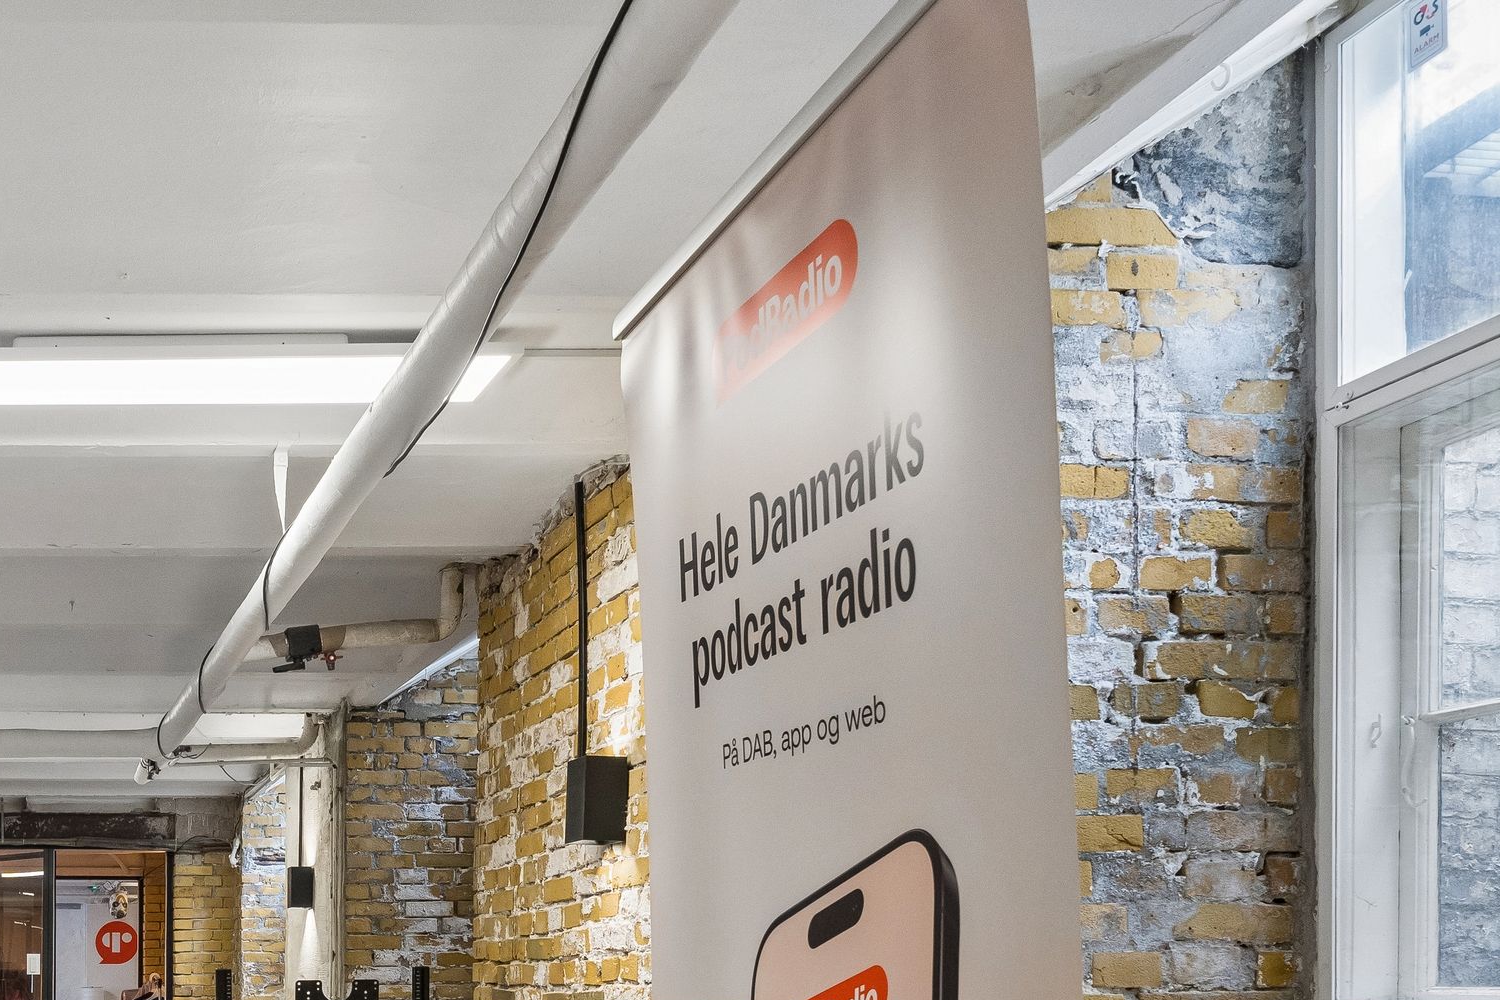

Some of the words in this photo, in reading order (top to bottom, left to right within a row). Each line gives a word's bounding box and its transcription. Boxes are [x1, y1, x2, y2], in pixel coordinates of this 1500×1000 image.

[679, 512, 739, 603] Hele
[750, 407, 924, 565] Danmarks
[692, 578, 807, 709] podcast
[821, 527, 916, 635] radio
[722, 738, 739, 769] På
[742, 729, 777, 763] DAB,
[781, 718, 811, 756] app
[817, 713, 840, 745] og
[844, 694, 886, 733] web
